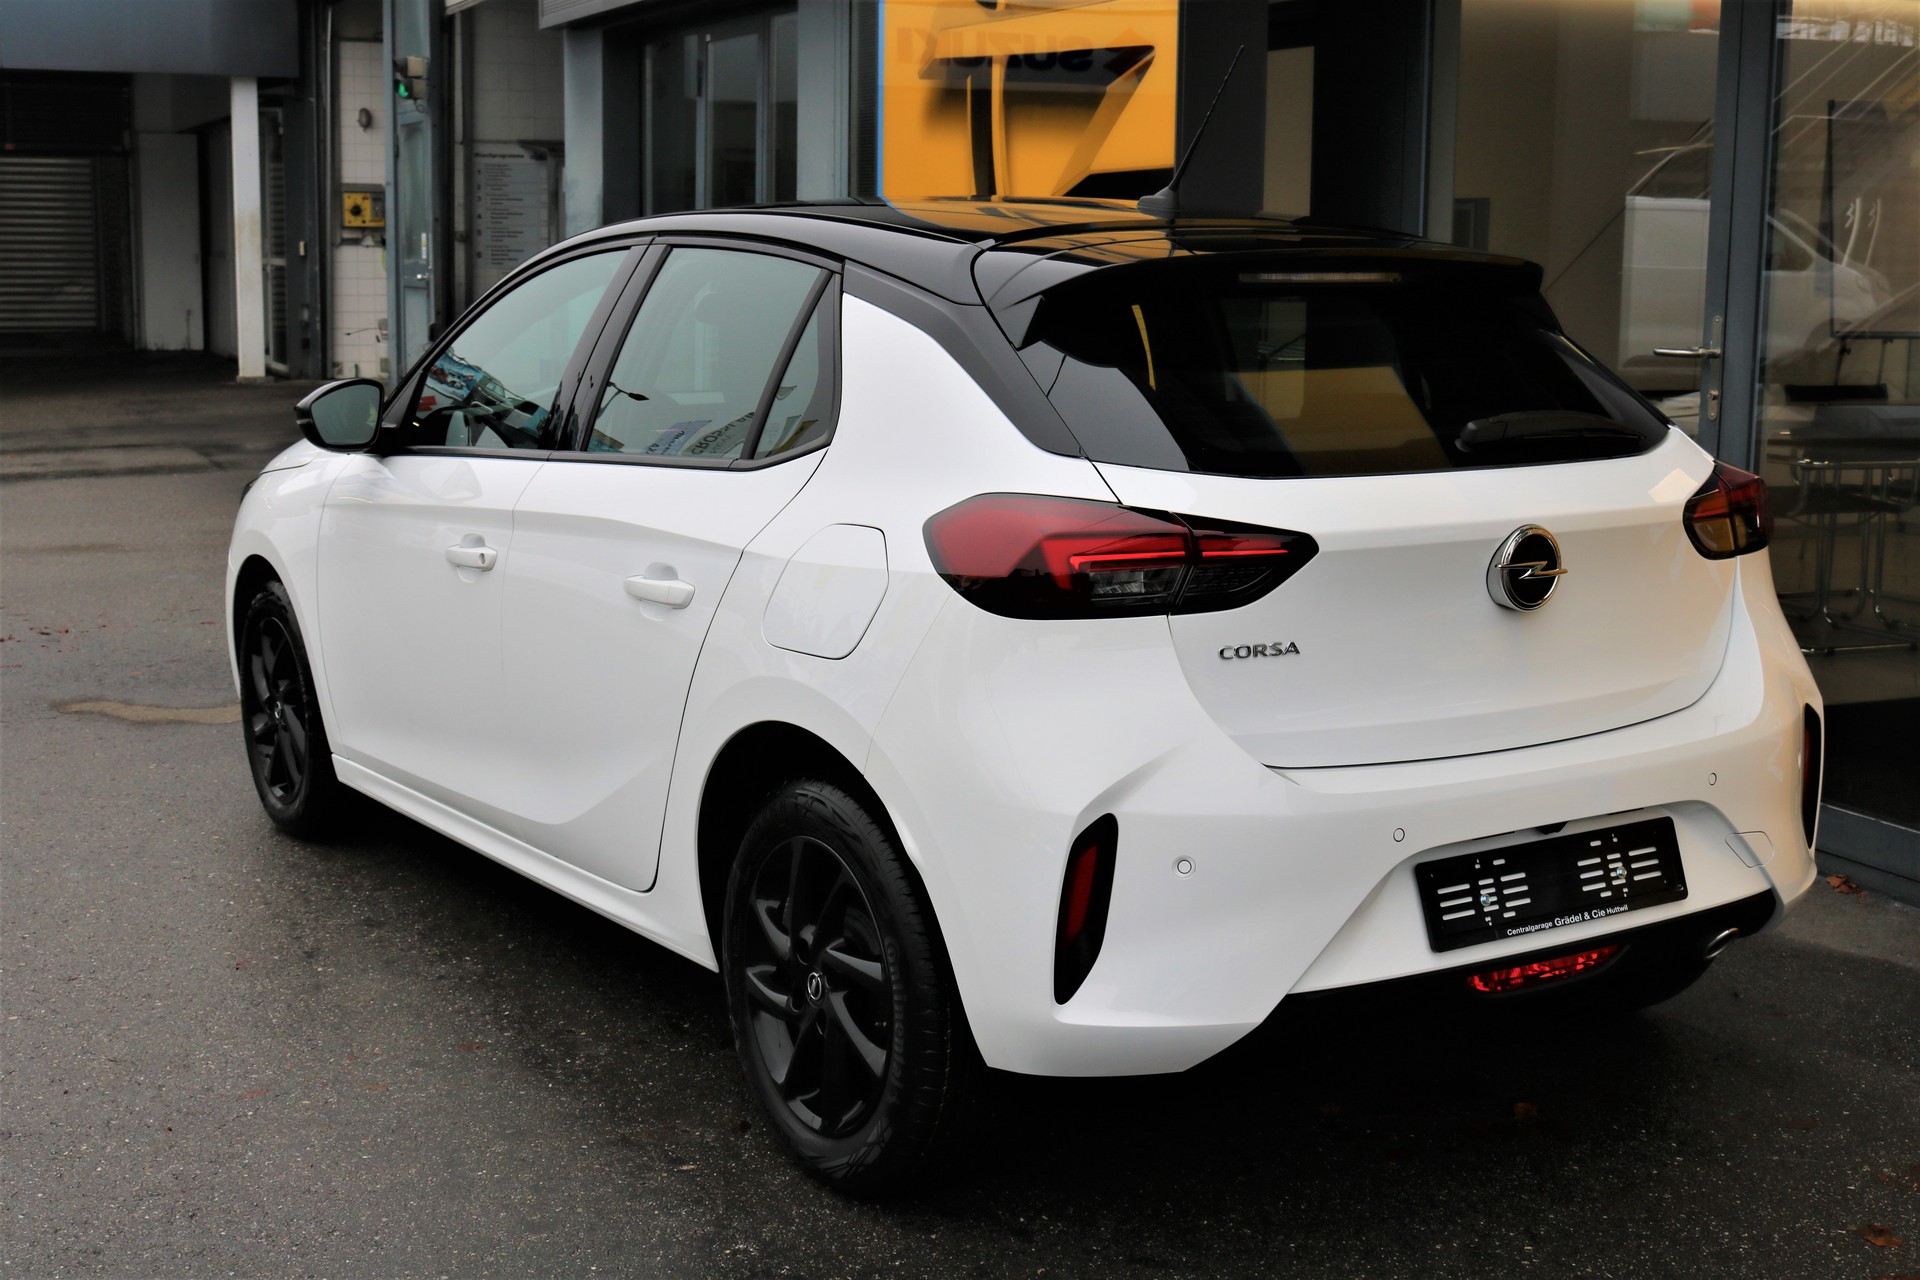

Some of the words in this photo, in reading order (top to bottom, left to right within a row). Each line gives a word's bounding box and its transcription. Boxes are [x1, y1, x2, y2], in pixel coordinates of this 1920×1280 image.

[1218, 641, 1301, 660] CORSA
[1507, 921, 1553, 936] Centralgarage
[1554, 913, 1582, 927] Grädel
[1584, 912, 1591, 920] &
[1592, 908, 1606, 918] Cie
[1606, 904, 1629, 915] Huttwil
